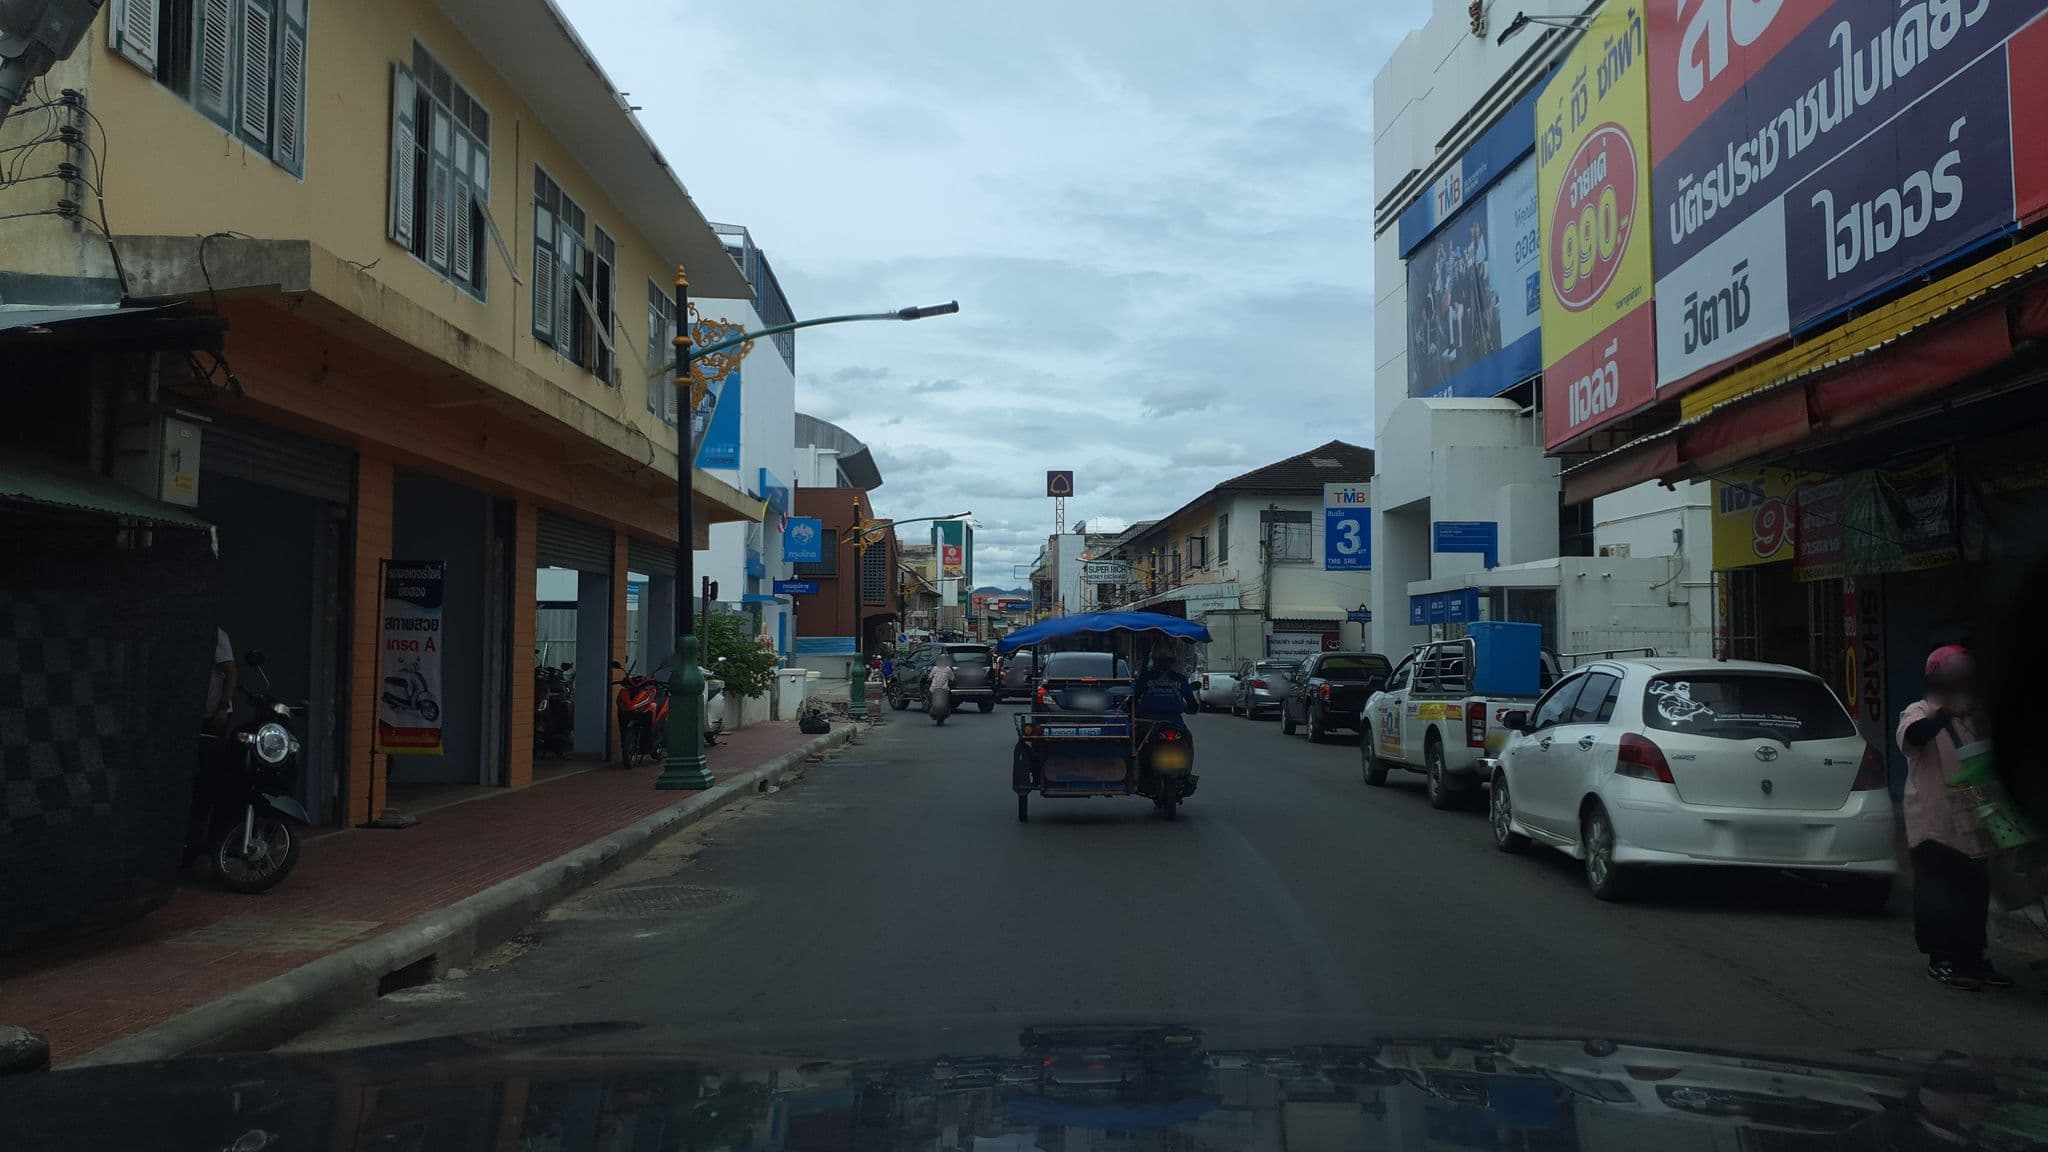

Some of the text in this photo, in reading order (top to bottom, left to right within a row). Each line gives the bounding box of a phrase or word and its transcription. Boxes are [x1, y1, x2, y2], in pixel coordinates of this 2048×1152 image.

[1541, 7, 1642, 168] แอร์ ทีวี ซักผ้า
[1438, 170, 1460, 216] TMB
[1811, 115, 1968, 281] ไฮเออร์
[1569, 338, 1619, 429] แอลจี
[1334, 488, 1365, 503] TMB
[1336, 519, 1362, 555] 3
[1088, 566, 1109, 574] SUPER
[384, 616, 439, 632] สภาพสวย
[386, 637, 436, 652] เกรด A
[1862, 591, 1881, 722] SHARP
